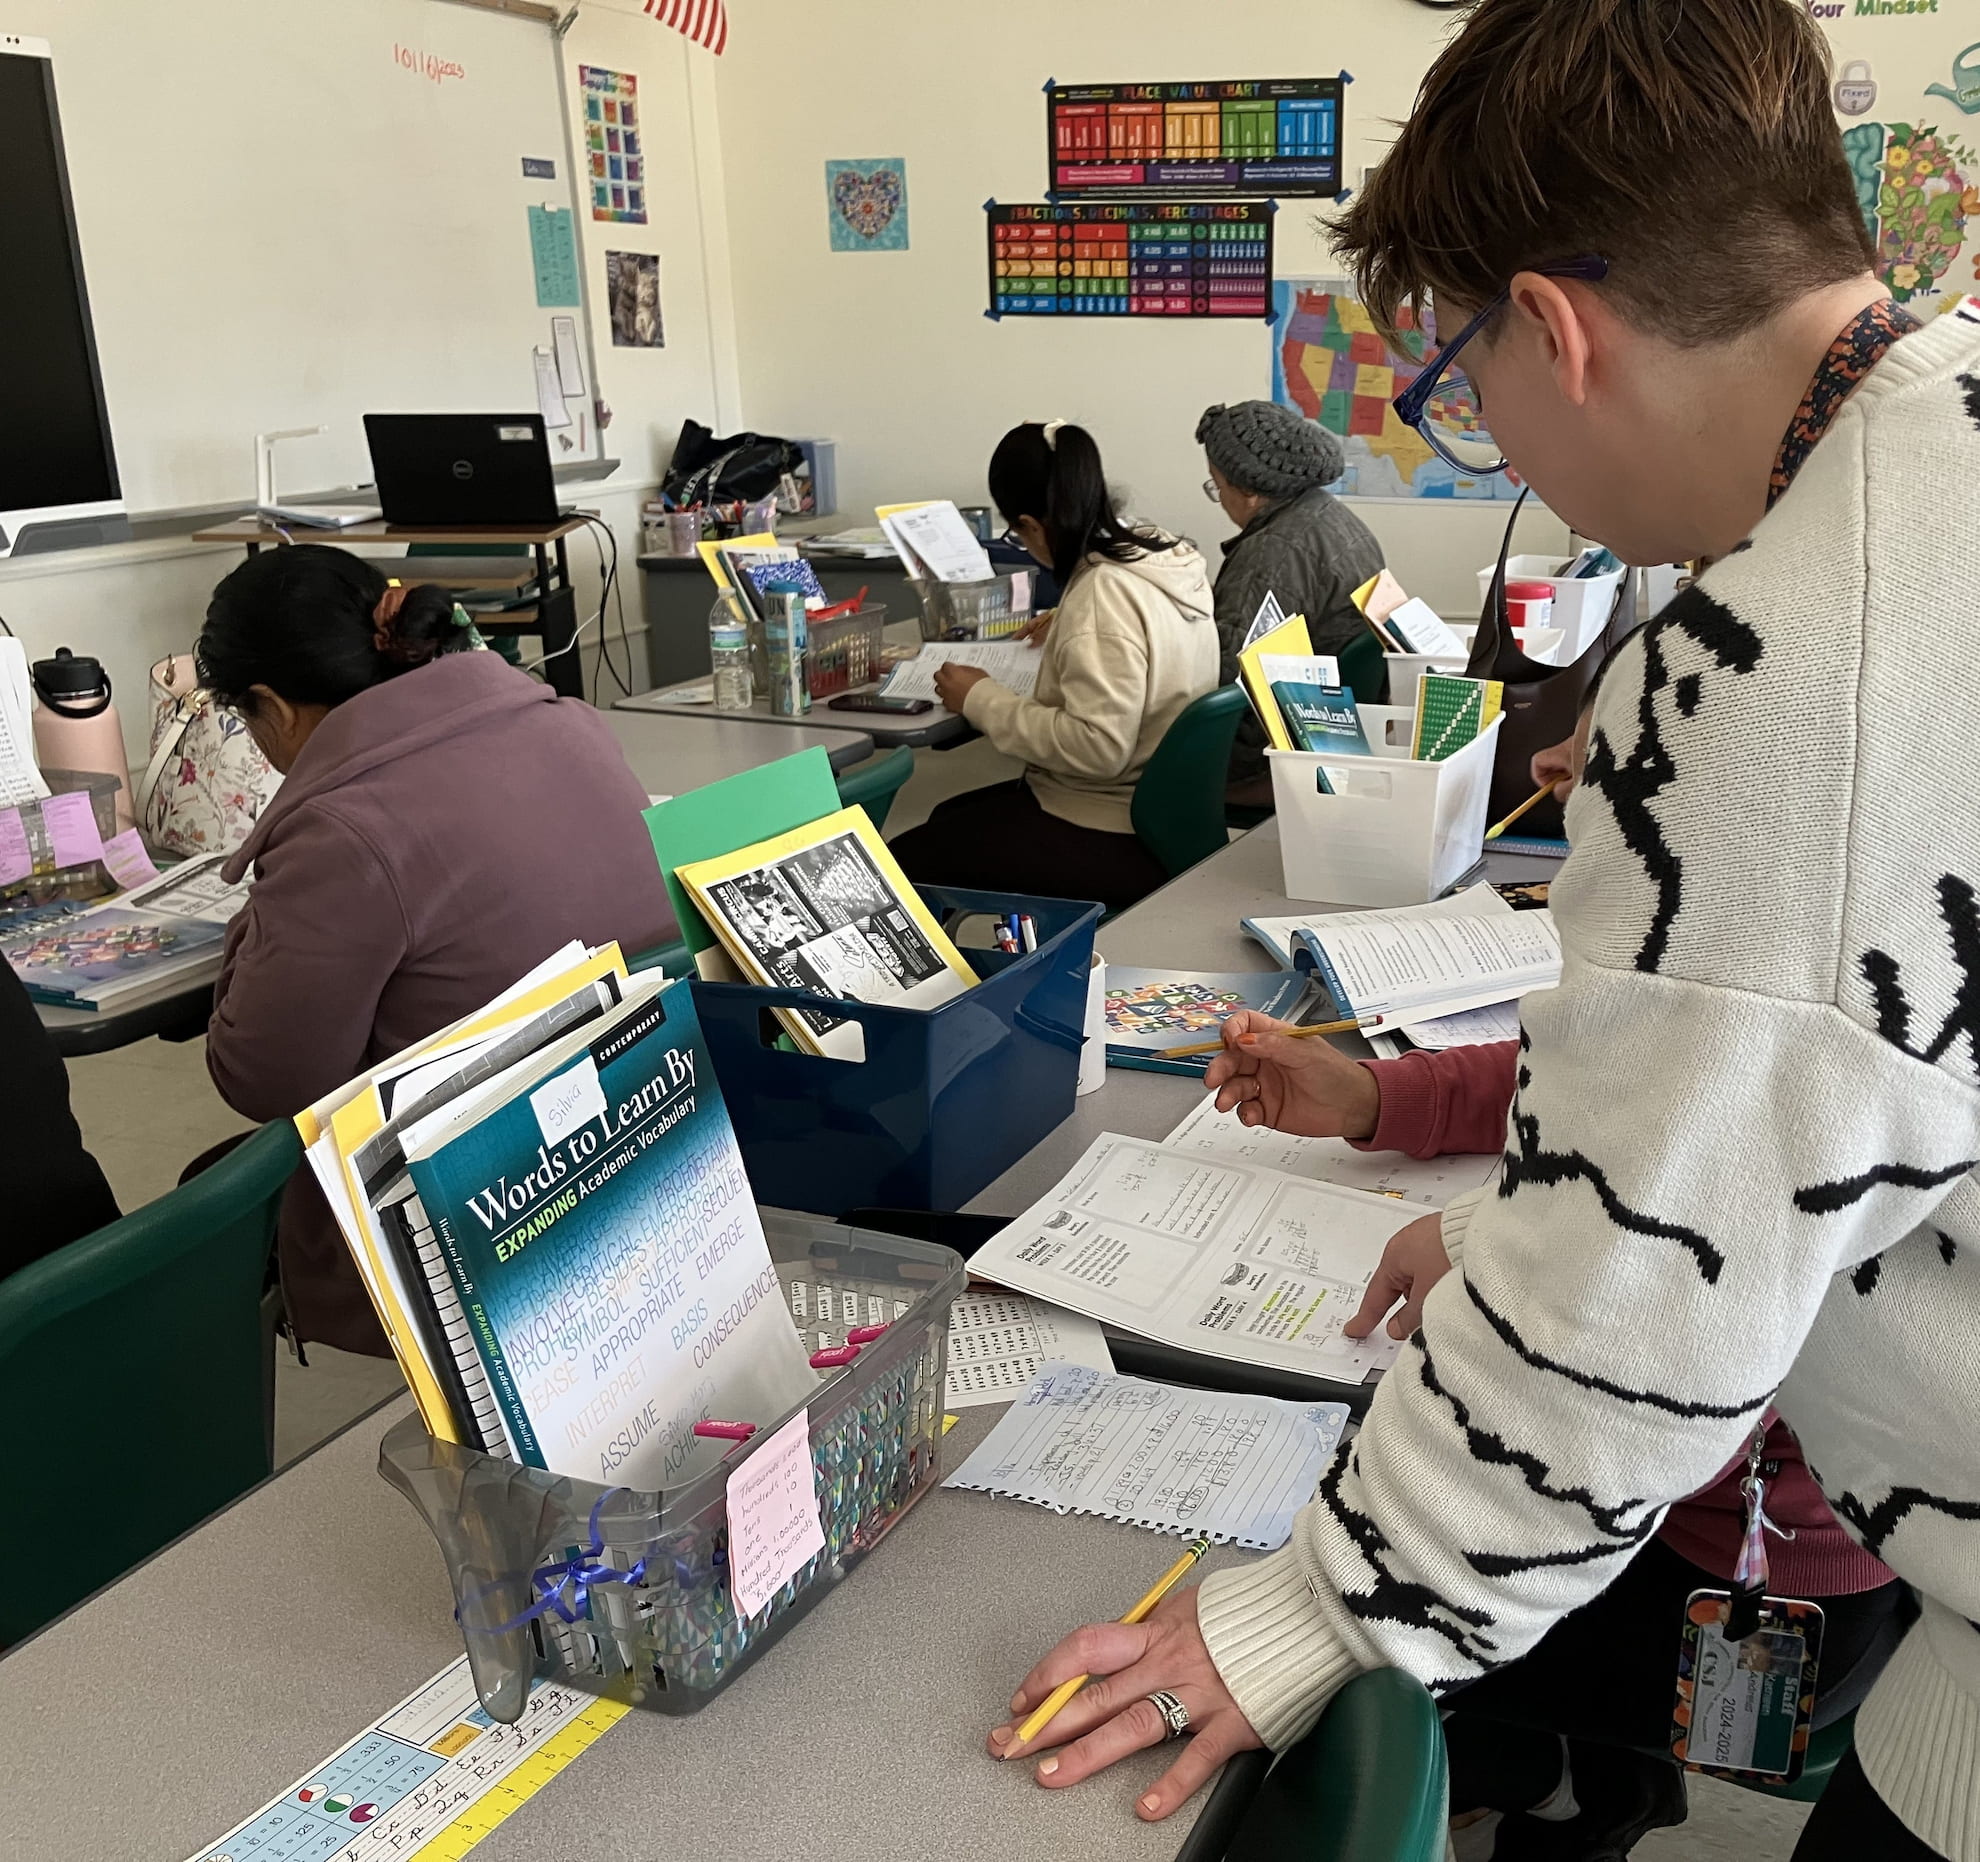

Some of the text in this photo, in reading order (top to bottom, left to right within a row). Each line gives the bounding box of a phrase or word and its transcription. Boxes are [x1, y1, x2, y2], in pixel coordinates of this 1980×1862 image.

[1855, 0, 1938, 16] Mindset
[1123, 84, 1161, 100] PLACE
[1170, 83, 1211, 98] VALUE
[1219, 82, 1261, 97] CHART
[1841, 89, 1870, 97] Fixed
[1157, 206, 1249, 220] PERCENTAGES
[716, 886, 738, 921] CIRCUS
[776, 960, 803, 989] Arts
[1331, 980, 1346, 1002] DEVELOP
[599, 1010, 661, 1061] CONTEMPORARY
[548, 1083, 582, 1128] Silvia
[464, 1046, 696, 1232] Words to Learn By
[494, 1094, 697, 1264] EXPANDING Academic Vocabulary
[439, 1217, 455, 1247] Words
[453, 1257, 467, 1283] Learn
[463, 1283, 473, 1295] By
[638, 1215, 710, 1298] SUFFICIENT
[696, 1214, 745, 1282] EMERGE
[505, 1291, 577, 1368] INVOLVE
[563, 1290, 631, 1362] SYMBOL
[592, 1271, 686, 1380] APPROPRIATE
[671, 1298, 709, 1351] BASIS
[693, 1262, 781, 1369] CONSEQUENCE
[1199, 1312, 1215, 1324] Daily
[1209, 1304, 1231, 1326] Problems
[471, 1303, 535, 1451] EXPANDING Academic Vocabulary
[564, 1353, 649, 1449] INTERPRET
[599, 1398, 661, 1480] ASSUME
[663, 1405, 712, 1481] ACHIEE
[786, 1480, 797, 1496] 10
[744, 1534, 762, 1556] one
[1701, 1651, 1718, 1688] CSJ
[1780, 1676, 1798, 1716] Staff
[1716, 1697, 1736, 1763] 2024-2025
